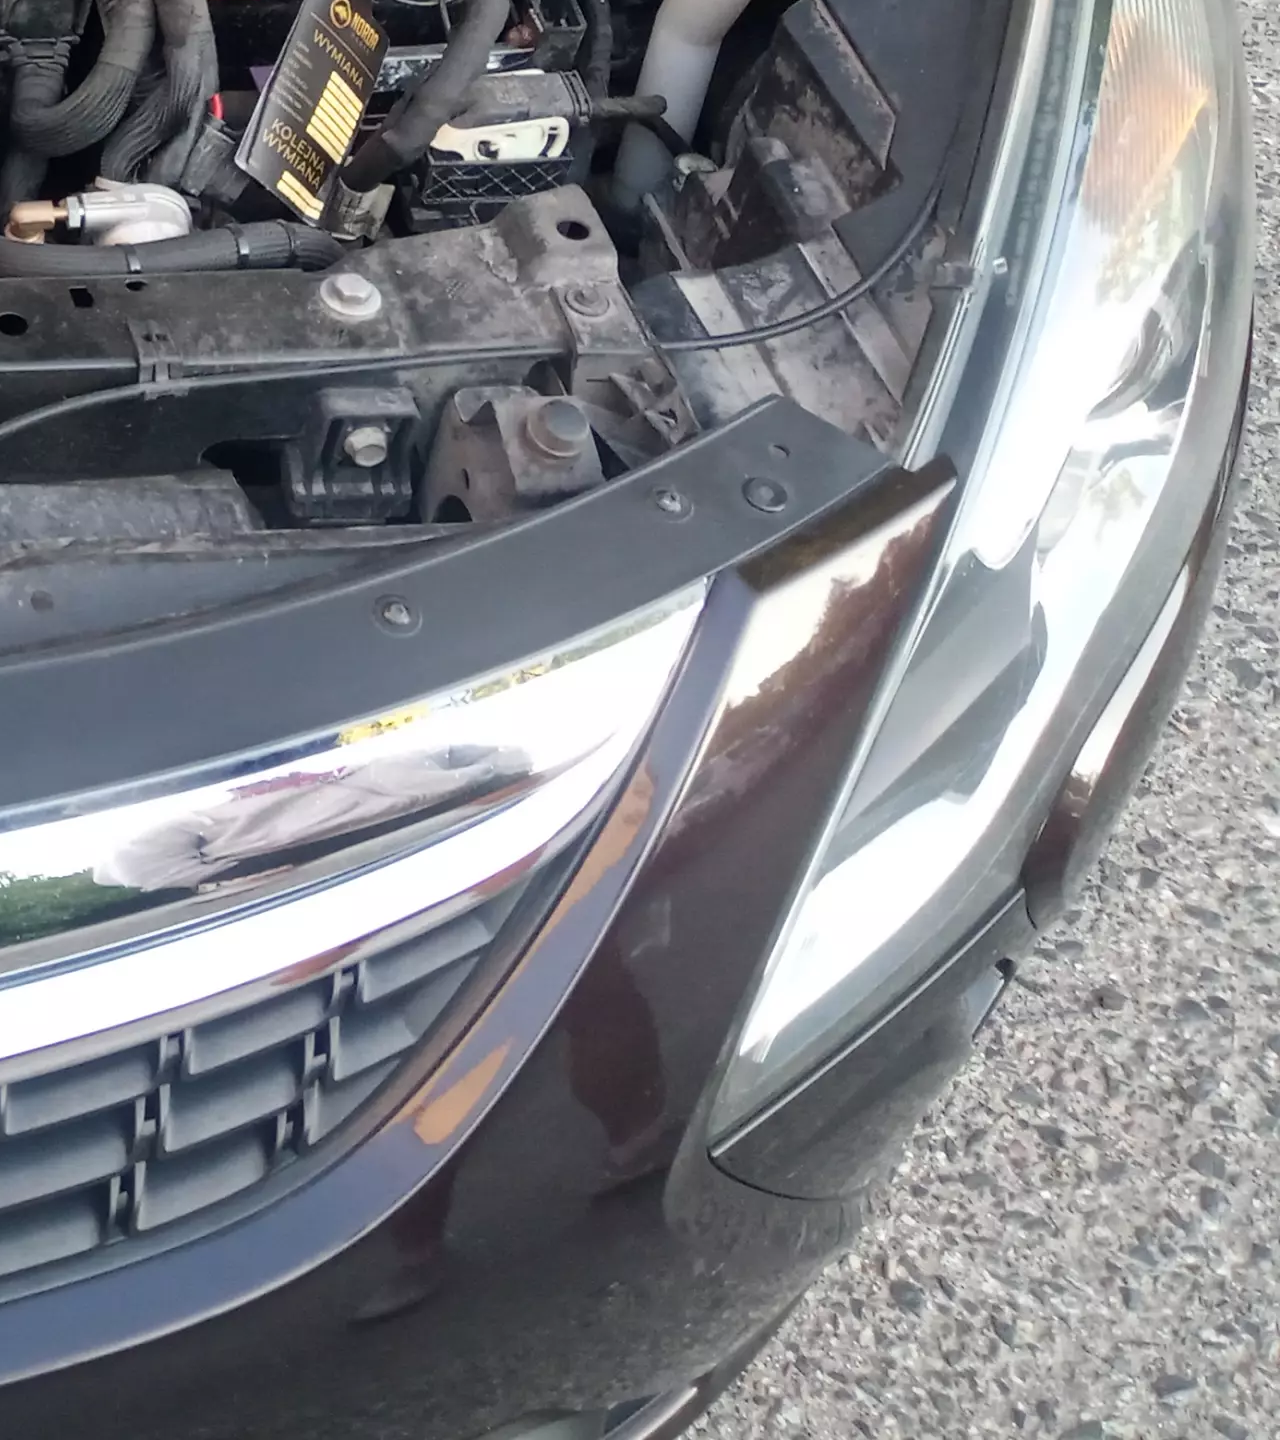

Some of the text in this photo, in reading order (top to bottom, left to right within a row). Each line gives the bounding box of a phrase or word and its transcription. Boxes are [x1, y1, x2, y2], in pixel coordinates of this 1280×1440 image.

[313, 28, 365, 90] WYMIANA
[261, 128, 322, 191] WYMIANA
[271, 117, 327, 174] KOLEJNA
